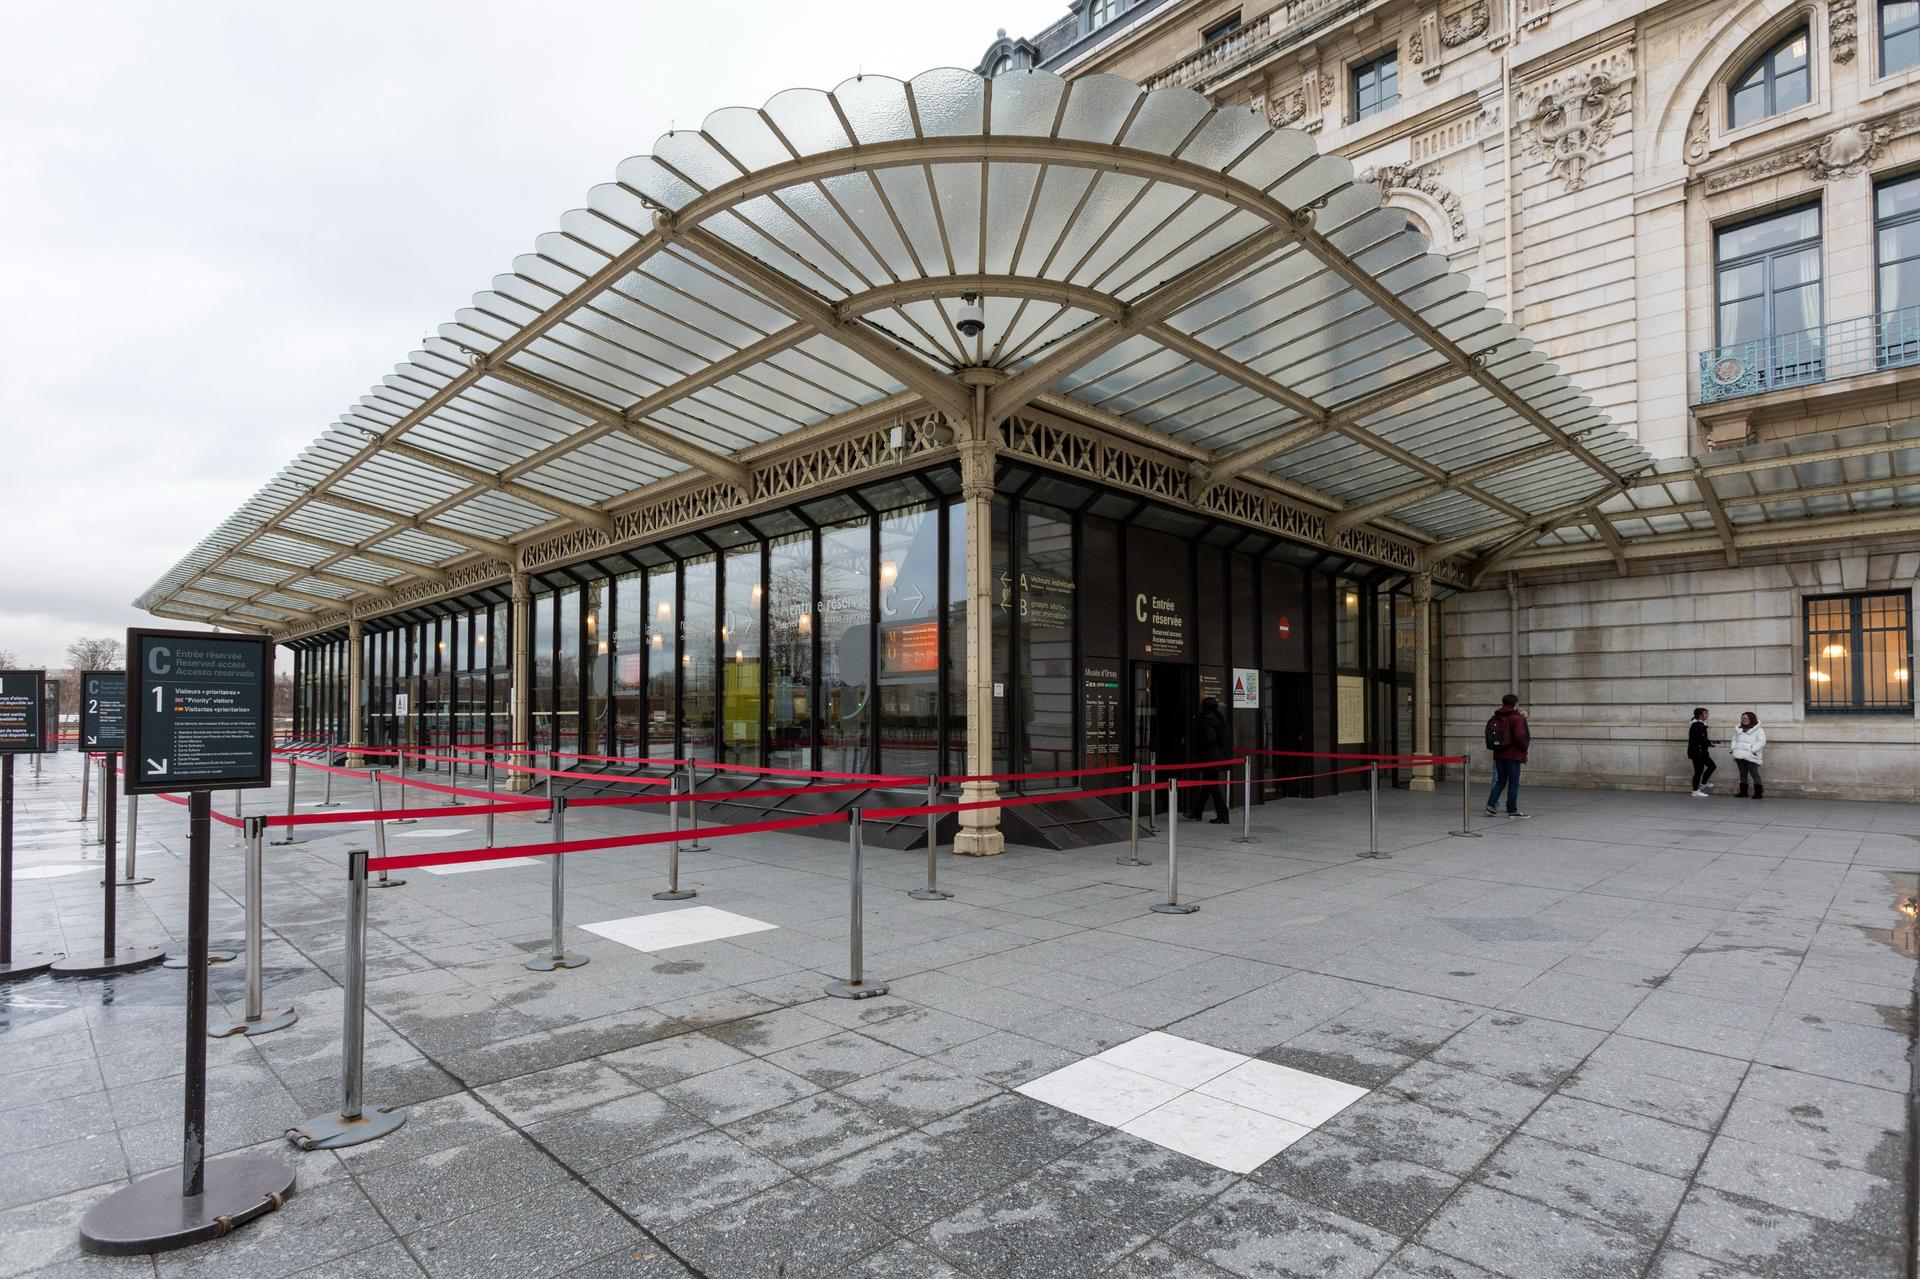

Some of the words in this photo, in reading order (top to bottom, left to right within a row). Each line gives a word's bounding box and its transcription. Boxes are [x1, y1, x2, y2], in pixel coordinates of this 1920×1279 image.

[1020, 573, 1028, 591] A
[1020, 599, 1028, 616] B
[1136, 593, 1148, 623] C
[1152, 596, 1175, 611] Entrée
[1152, 612, 1183, 627] réservée
[148, 646, 171, 675] C
[176, 649, 204, 658] Entrée
[206, 650, 242, 660] réservée
[176, 658, 216, 668] Reserved
[218, 661, 246, 669] access
[214, 669, 255, 678] reservado
[89, 679, 99, 695] C
[206, 688, 236, 696] prioritaires
[88, 699, 98, 714] 2
[152, 686, 163, 713] 1
